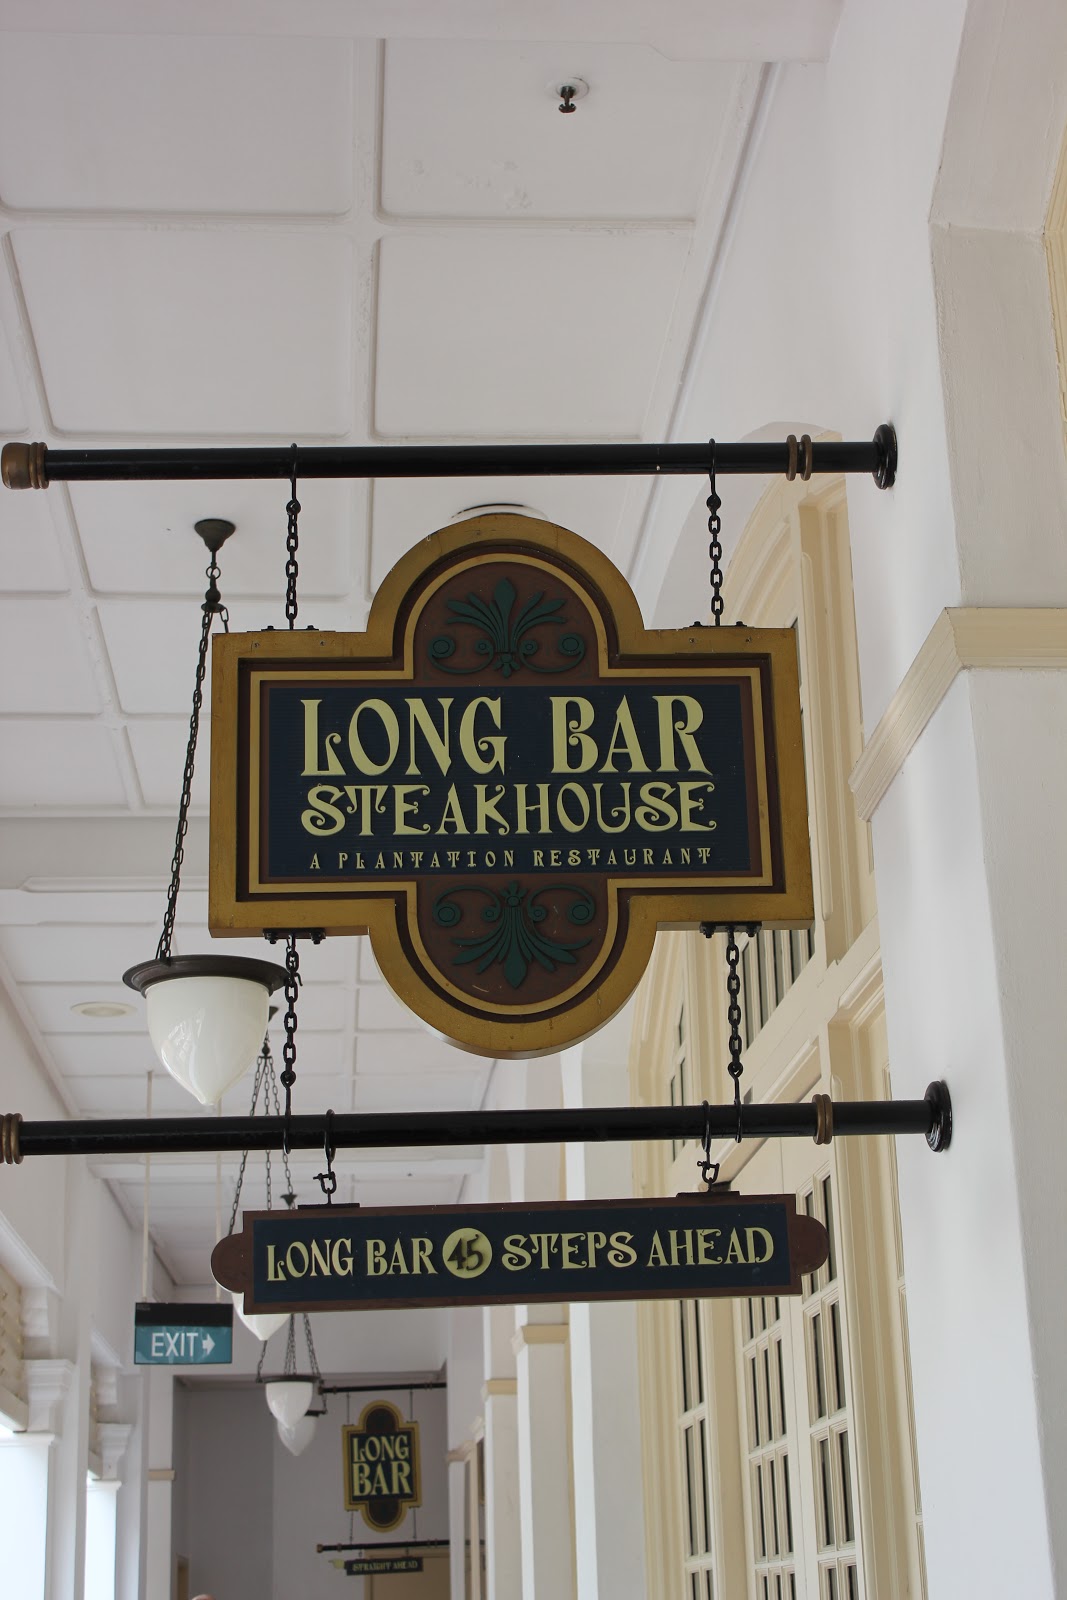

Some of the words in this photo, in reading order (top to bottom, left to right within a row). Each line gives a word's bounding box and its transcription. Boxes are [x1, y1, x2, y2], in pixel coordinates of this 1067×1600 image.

[300, 696, 507, 777] LONG
[549, 694, 713, 776] BAR
[300, 781, 717, 836] STEAKHOUSE
[309, 853, 321, 869] A
[338, 850, 515, 870] PLANTATION
[532, 847, 712, 867] RESTAURANT
[266, 1238, 354, 1282] LONG
[366, 1237, 438, 1276] BAR
[447, 1233, 484, 1271] 45
[501, 1231, 638, 1271] STEPS
[646, 1226, 775, 1268] AHEAD
[151, 1332, 199, 1357] EXIT
[352, 1434, 409, 1462] LONG
[352, 1460, 412, 1496] BAR
